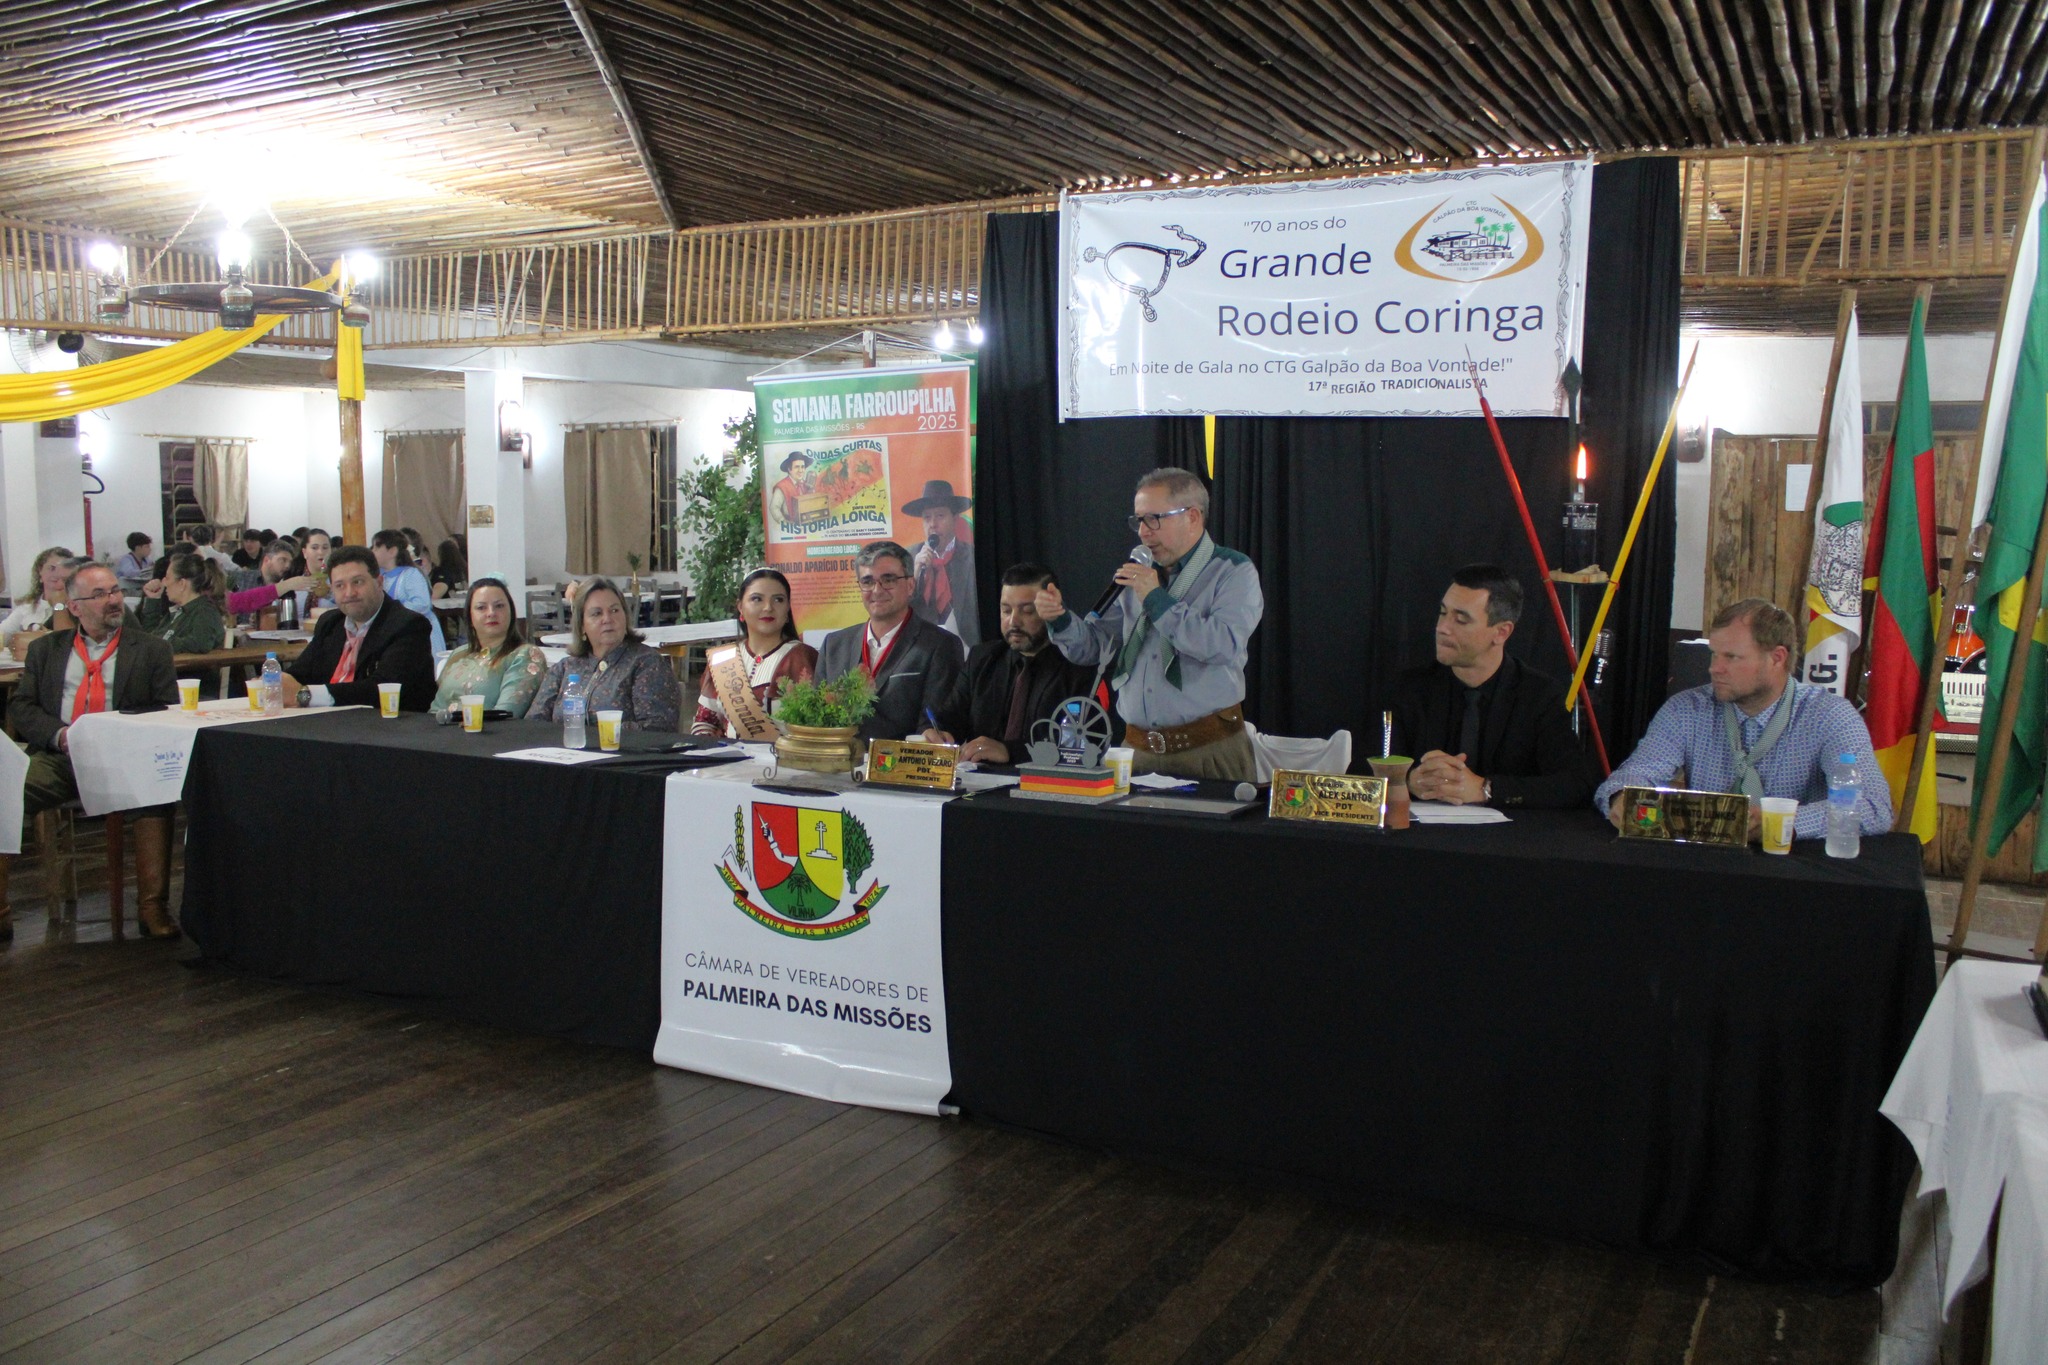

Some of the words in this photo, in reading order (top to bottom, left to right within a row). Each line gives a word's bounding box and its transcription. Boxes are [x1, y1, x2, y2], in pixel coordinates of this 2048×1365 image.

[1433, 210, 1456, 223] GALPÃO
[1480, 206, 1507, 219] VONTADE
[1243, 220, 1272, 233] "70
[1276, 219, 1319, 232] anos
[1323, 216, 1347, 230] do
[1220, 243, 1372, 279] Grande
[1218, 302, 1359, 337] Rodeio
[1375, 299, 1544, 342] Coringa
[1109, 363, 1128, 376] Em
[1131, 361, 1170, 374] Noite
[1174, 361, 1194, 374] de
[1198, 360, 1233, 374] Gala
[1238, 362, 1259, 374] no
[1264, 360, 1296, 374] CTG
[1302, 359, 1360, 376] Galpão
[1365, 359, 1385, 373] da
[1391, 359, 1423, 373] Boa
[1428, 357, 1513, 373] Vontade!"
[1308, 381, 1328, 392] 17ª
[1331, 381, 1376, 394] REGIÃO
[1381, 377, 1488, 390] TRADICIONALISTA
[772, 394, 842, 424] SEMANA
[845, 386, 957, 419] FARROUPILHA
[774, 426, 805, 435] PALMEIRA
[806, 424, 819, 433] DAS
[819, 422, 850, 432] MISSÕES
[855, 422, 865, 430] RS
[917, 413, 957, 431] 2025
[806, 448, 840, 460] ONDAS
[842, 439, 883, 454] CURTAS
[842, 510, 887, 525] LONGA
[804, 558, 839, 573] APARÍCIO
[840, 559, 849, 571] DE
[723, 676, 766, 739] Prenda
[898, 756, 926, 765] ANTONIO
[899, 748, 934, 756] VEREADOR
[905, 774, 941, 782] PRESIDENTE
[1318, 790, 1340, 800] ALEX
[1341, 791, 1374, 803] SANTOS
[1335, 802, 1353, 811] PDT
[1331, 812, 1375, 820] PRESIDENTE
[864, 890, 879, 906] 1874
[735, 897, 786, 932] PALMEIRA
[794, 928, 815, 937] DAS
[685, 950, 754, 976] CÂMARA
[760, 963, 780, 981] DE
[786, 967, 900, 999] VEREADORES
[907, 985, 929, 1003] DE
[683, 979, 781, 1011] PALMEIRA
[787, 994, 828, 1018] DAS
[833, 1003, 932, 1034] MISSÕES
